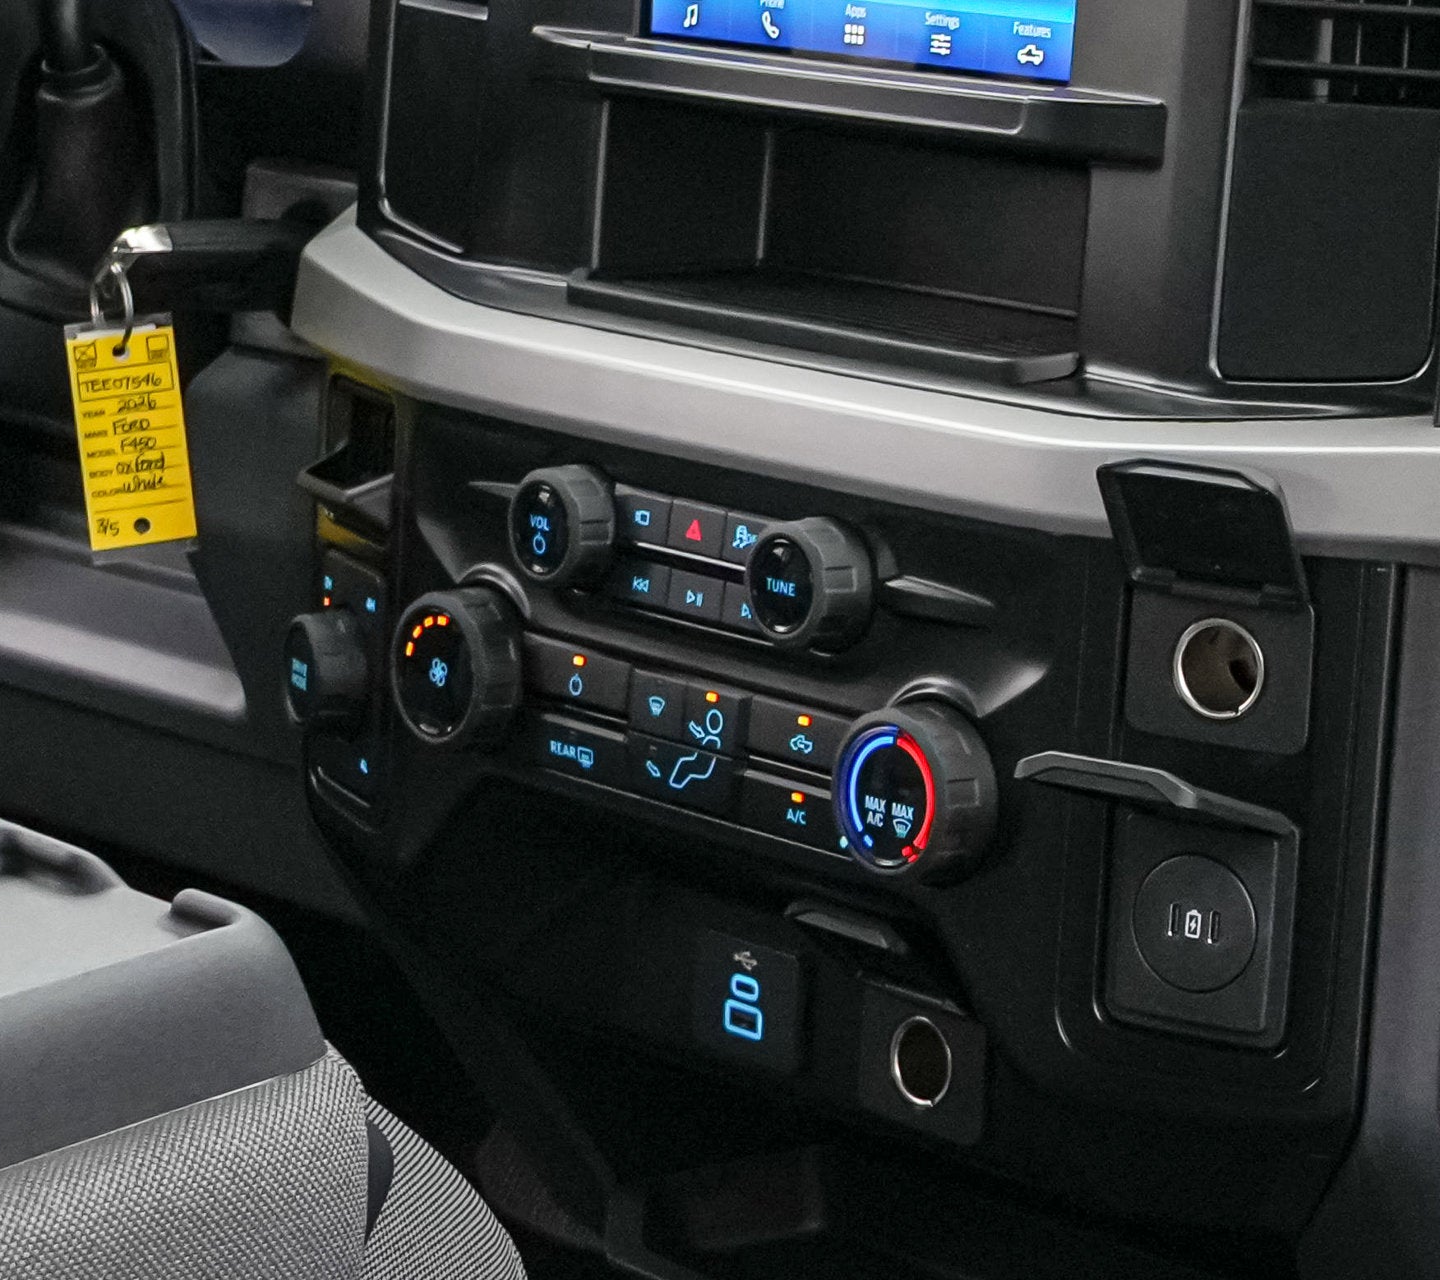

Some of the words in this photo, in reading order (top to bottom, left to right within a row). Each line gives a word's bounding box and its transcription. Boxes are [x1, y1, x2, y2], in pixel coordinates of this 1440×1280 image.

[844, 3, 867, 20] Apps
[924, 11, 960, 31] Settings
[1013, 21, 1052, 39] Features
[529, 514, 551, 532] VOL
[766, 577, 796, 597] TUNE
[550, 740, 577, 759] REAR
[865, 795, 886, 814] MAX
[891, 802, 915, 821] MAX
[786, 808, 807, 826] A/C
[866, 812, 884, 828] A/C
